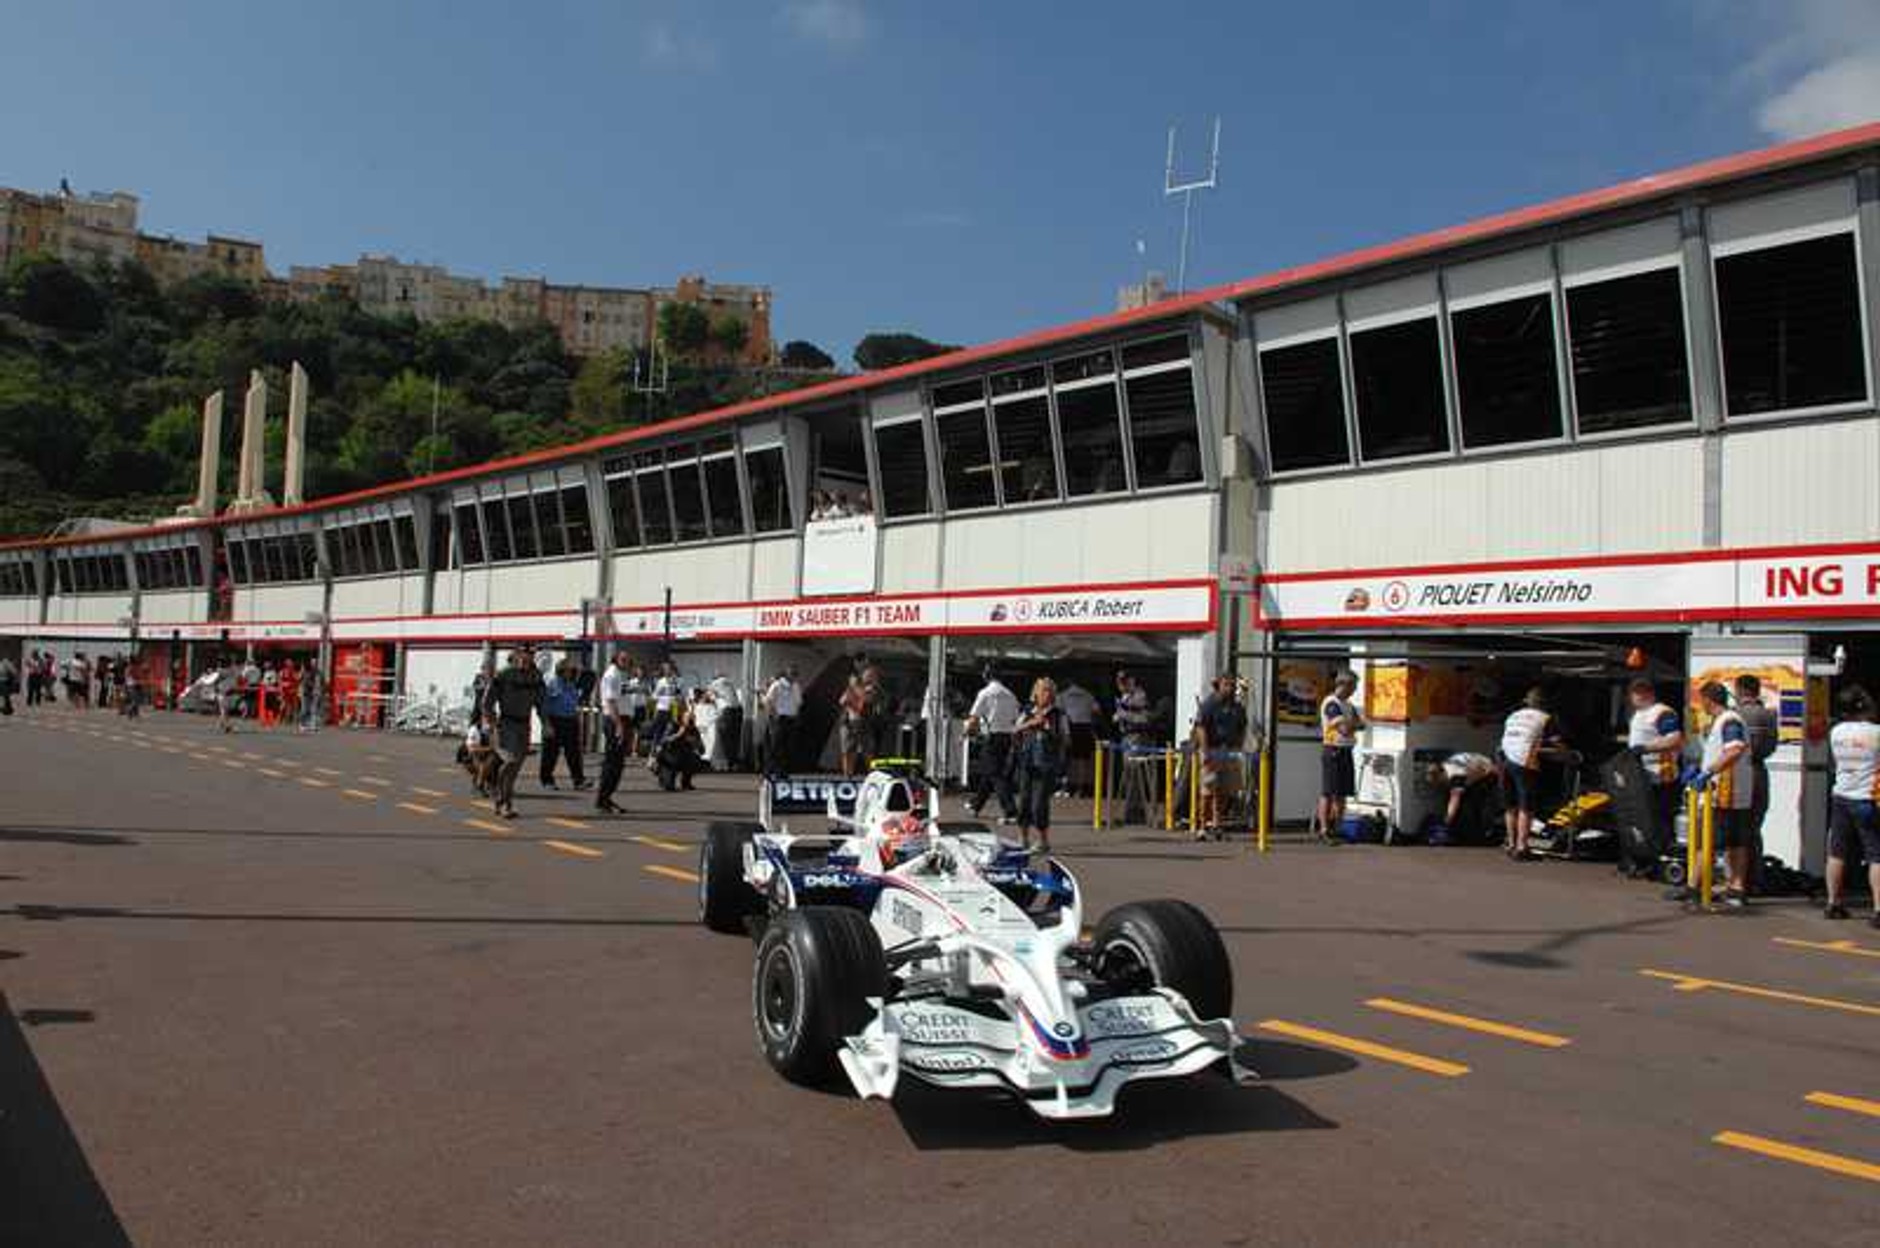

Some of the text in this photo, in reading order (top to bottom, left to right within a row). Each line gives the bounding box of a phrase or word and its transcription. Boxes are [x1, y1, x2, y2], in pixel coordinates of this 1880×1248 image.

[1419, 582, 1495, 606] PIQUET
[1497, 579, 1593, 603] Nelsinho
[1766, 564, 1844, 598] ING
[759, 604, 921, 627] BMW SAUBER F1 TEAM
[1037, 599, 1089, 619] KUBICA
[1092, 598, 1144, 617] Robert
